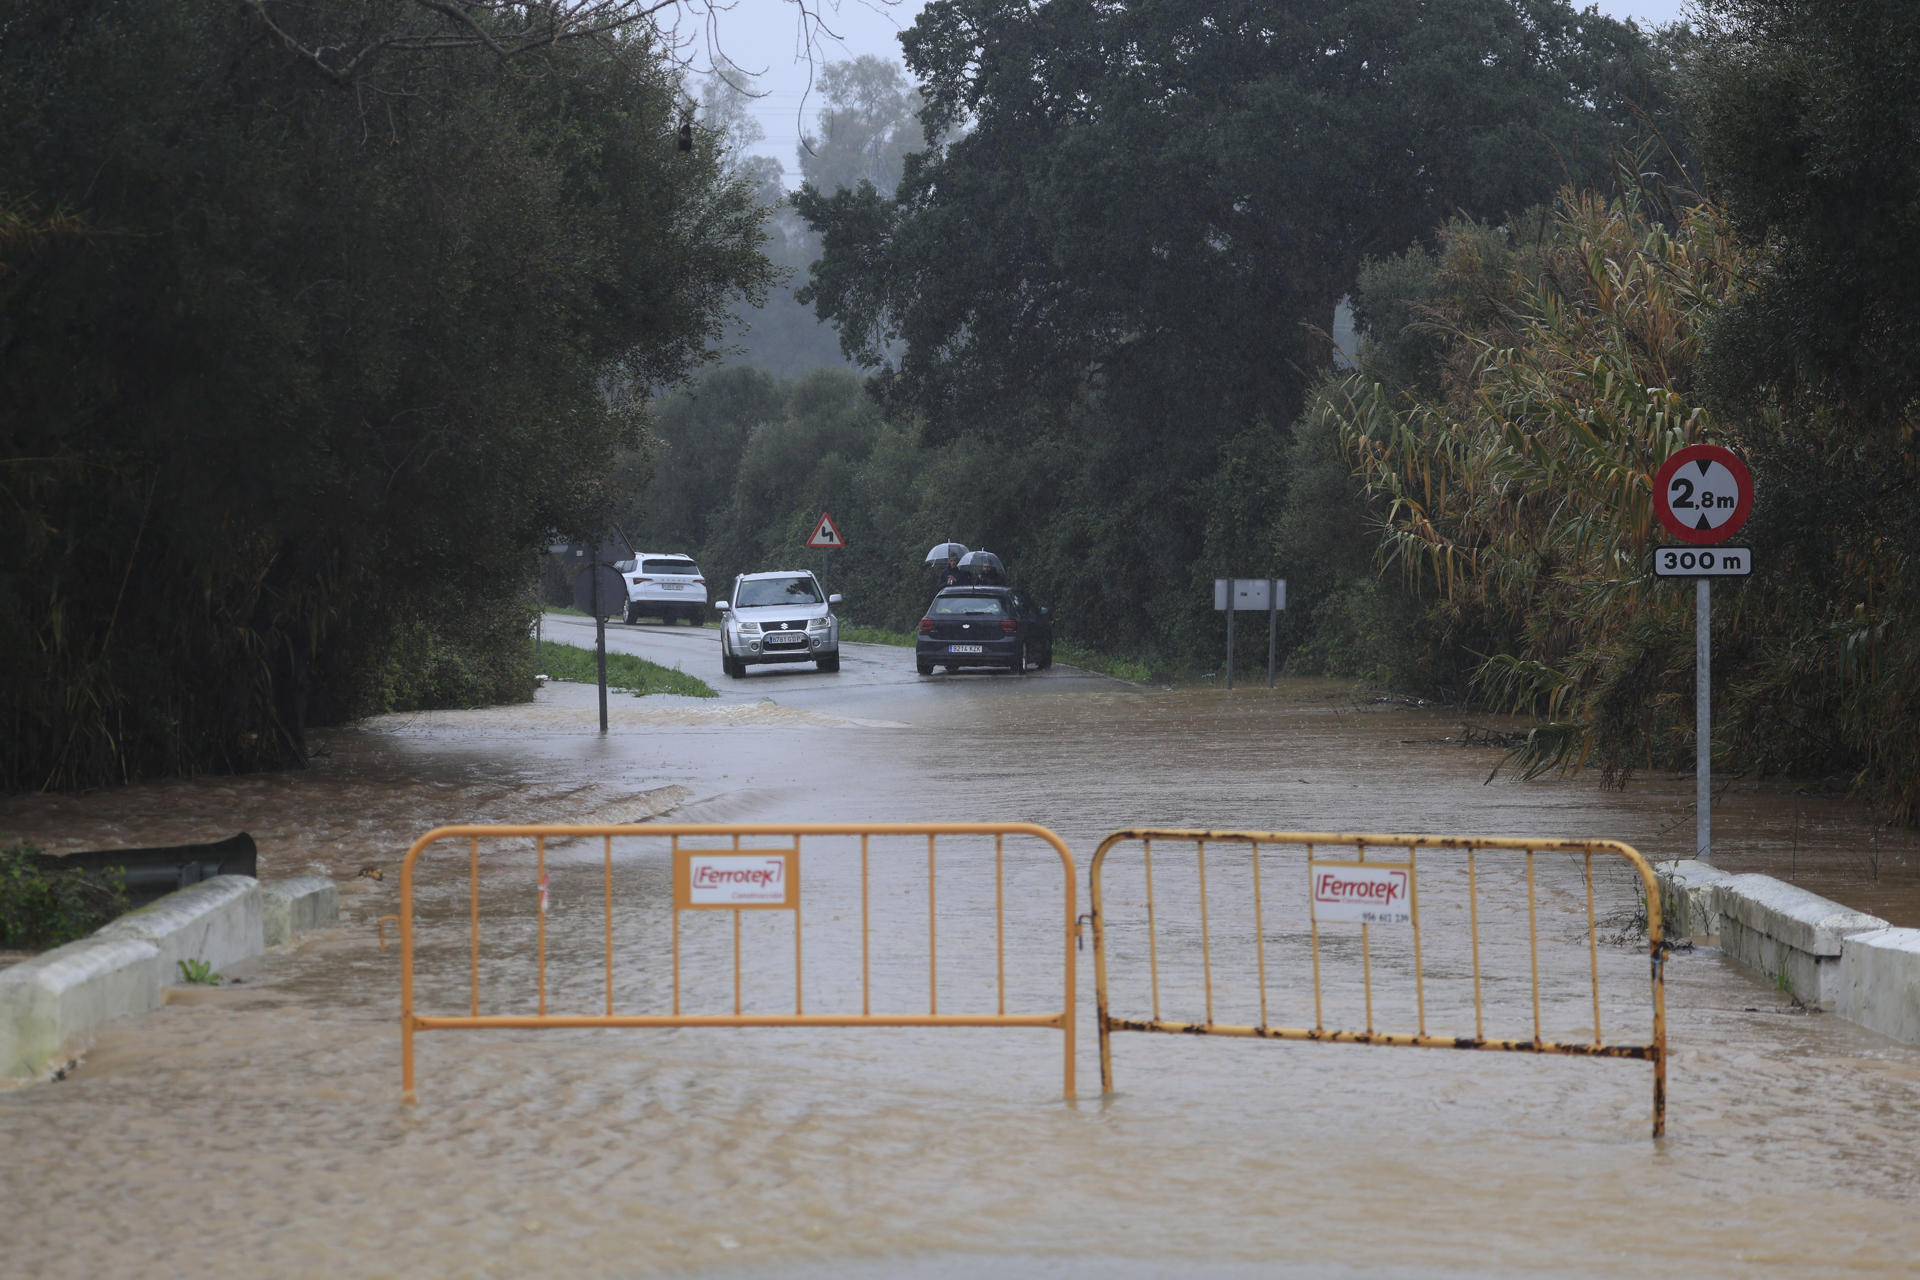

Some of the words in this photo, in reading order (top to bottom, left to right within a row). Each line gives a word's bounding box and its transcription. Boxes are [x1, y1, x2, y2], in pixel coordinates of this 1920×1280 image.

[1664, 552, 1715, 570] 300
[1723, 556, 1741, 570] m
[699, 866, 775, 888] Ferrotek
[1321, 874, 1399, 906] Ferrotek
